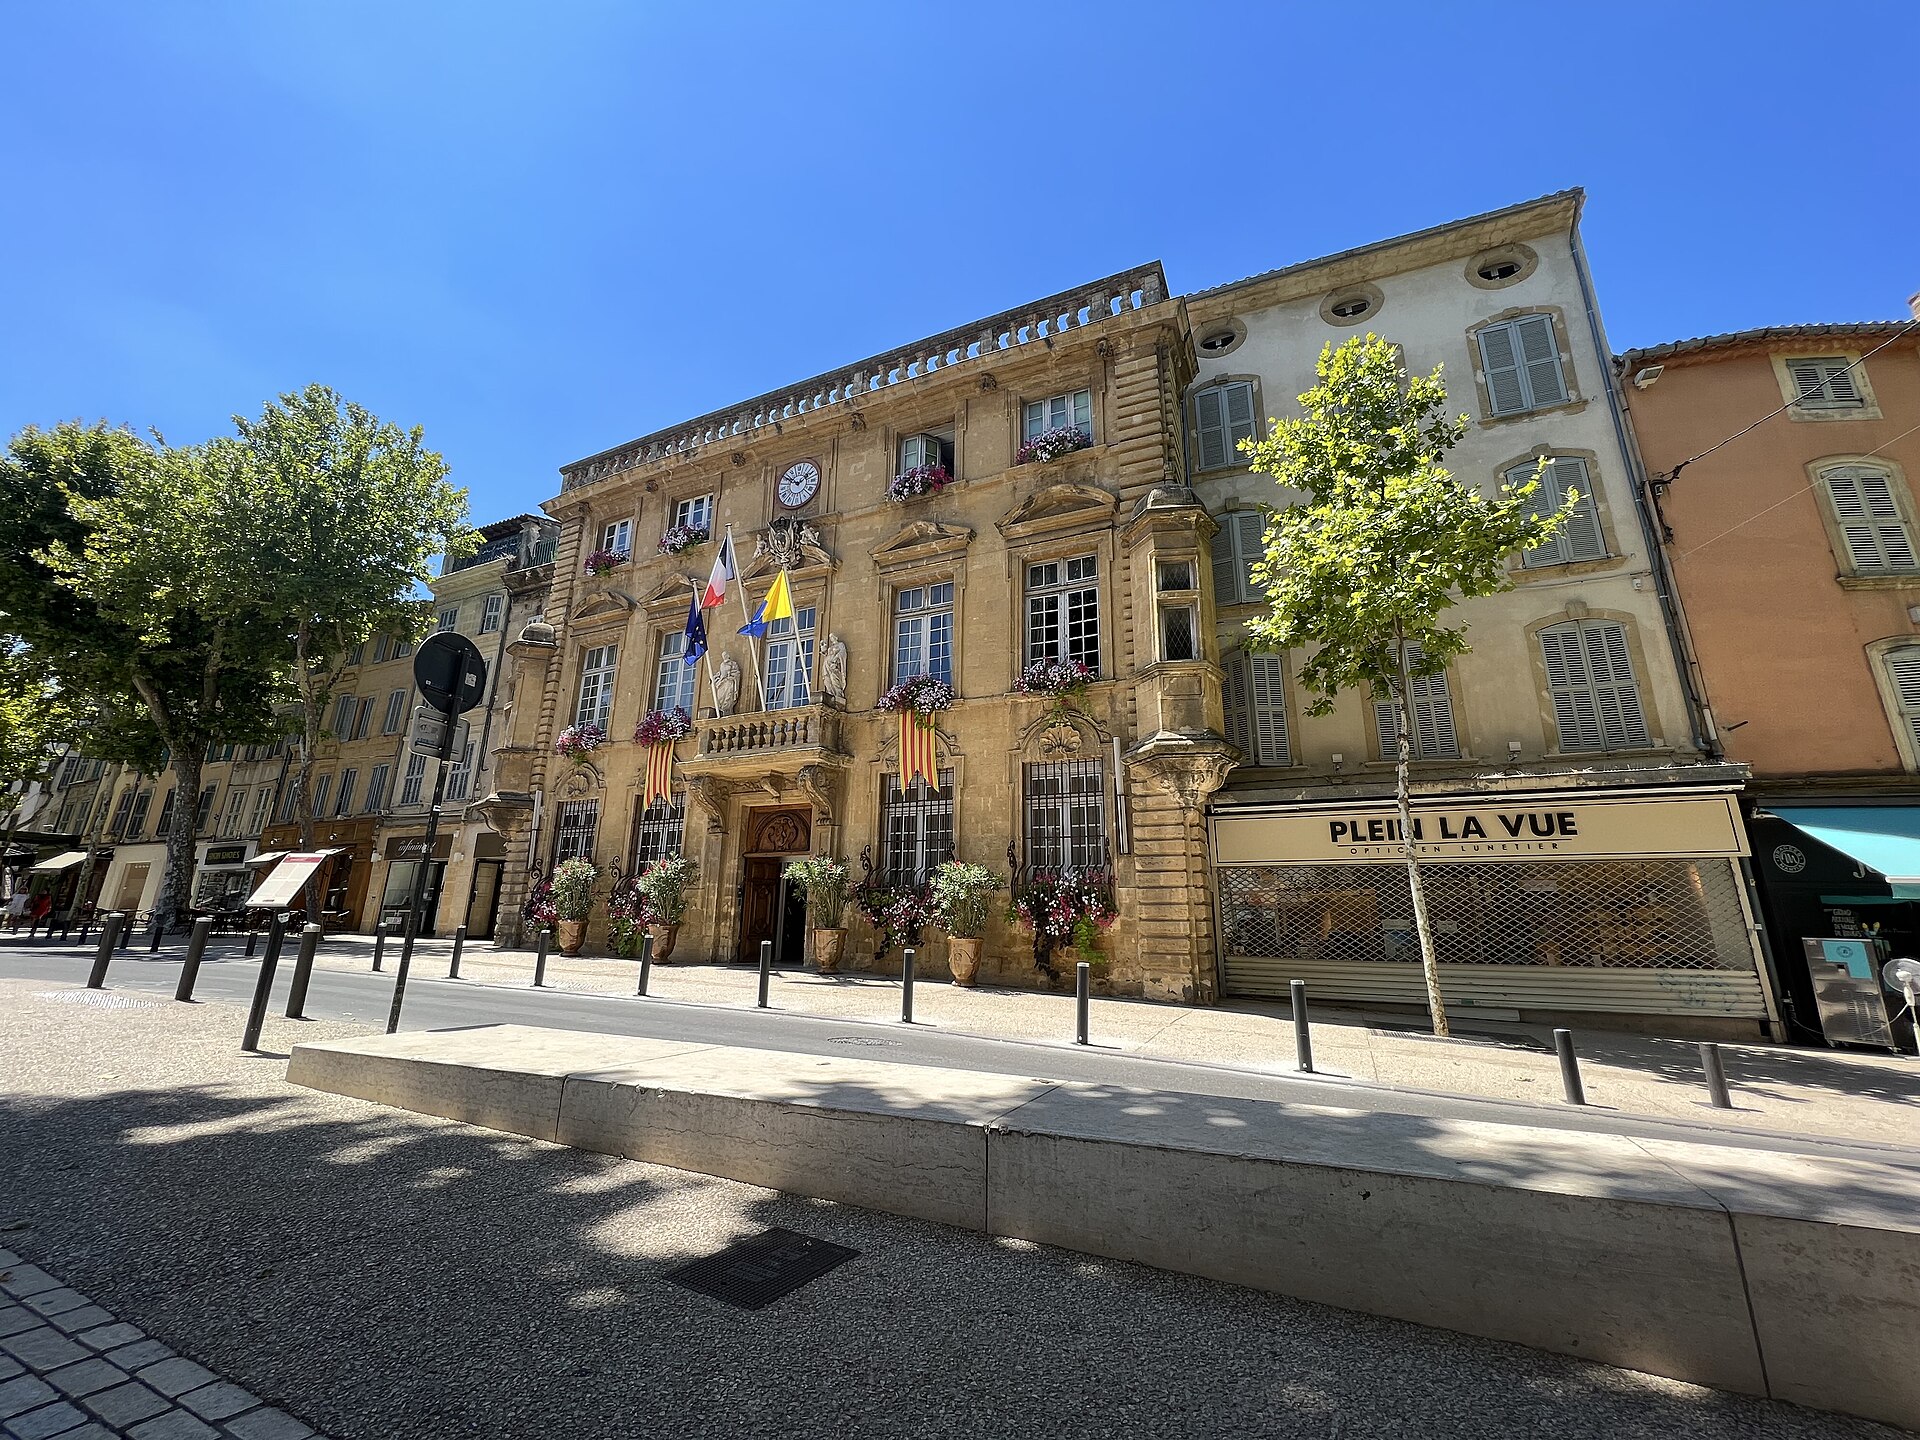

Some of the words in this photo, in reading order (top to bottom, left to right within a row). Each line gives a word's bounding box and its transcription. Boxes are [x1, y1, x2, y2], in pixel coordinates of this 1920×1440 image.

[1439, 815, 1488, 840] LA
[1498, 812, 1578, 838] VUE
[1350, 846, 1441, 855] OPTICEN
[1461, 843, 1559, 852] LUNETIER
